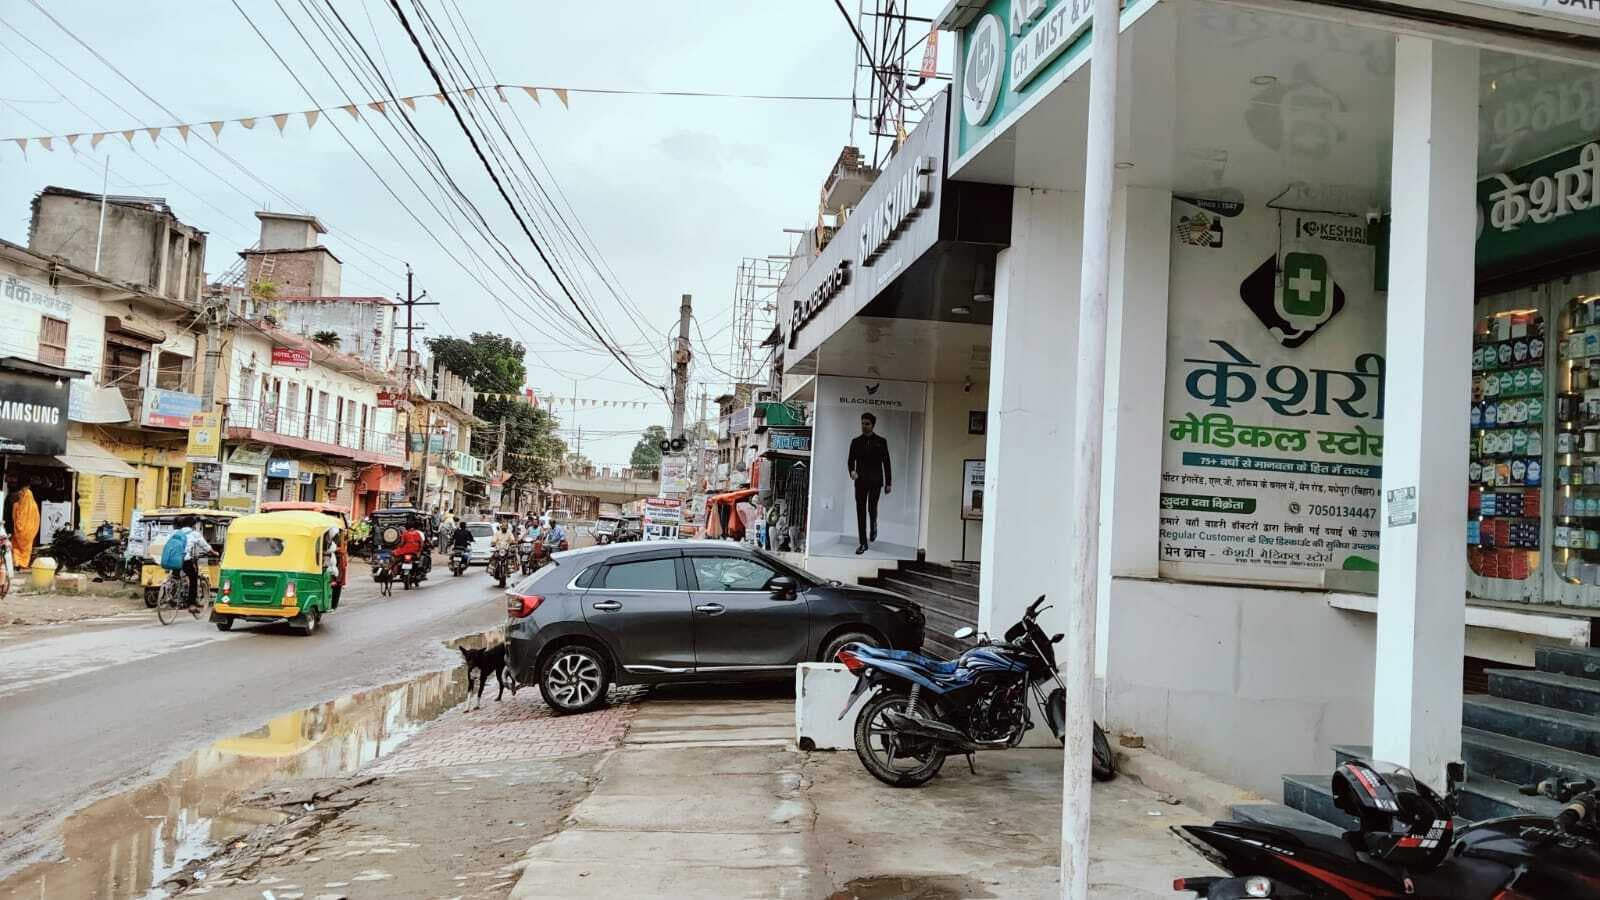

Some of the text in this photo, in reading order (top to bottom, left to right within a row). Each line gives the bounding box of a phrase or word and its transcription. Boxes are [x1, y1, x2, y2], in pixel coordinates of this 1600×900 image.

[859, 156, 923, 266] SAMSUNG
[1184, 339, 1384, 419] केशरी
[839, 396, 903, 407] BLACKBERRYS
[0, 400, 59, 425] AMSUNG
[1169, 413, 1310, 451] मेडिकल
[1308, 505, 1377, 519] 7050134447
[1159, 529, 1196, 540] Regular
[1199, 531, 1245, 543] Customer
[1165, 543, 1180, 557] मेन
